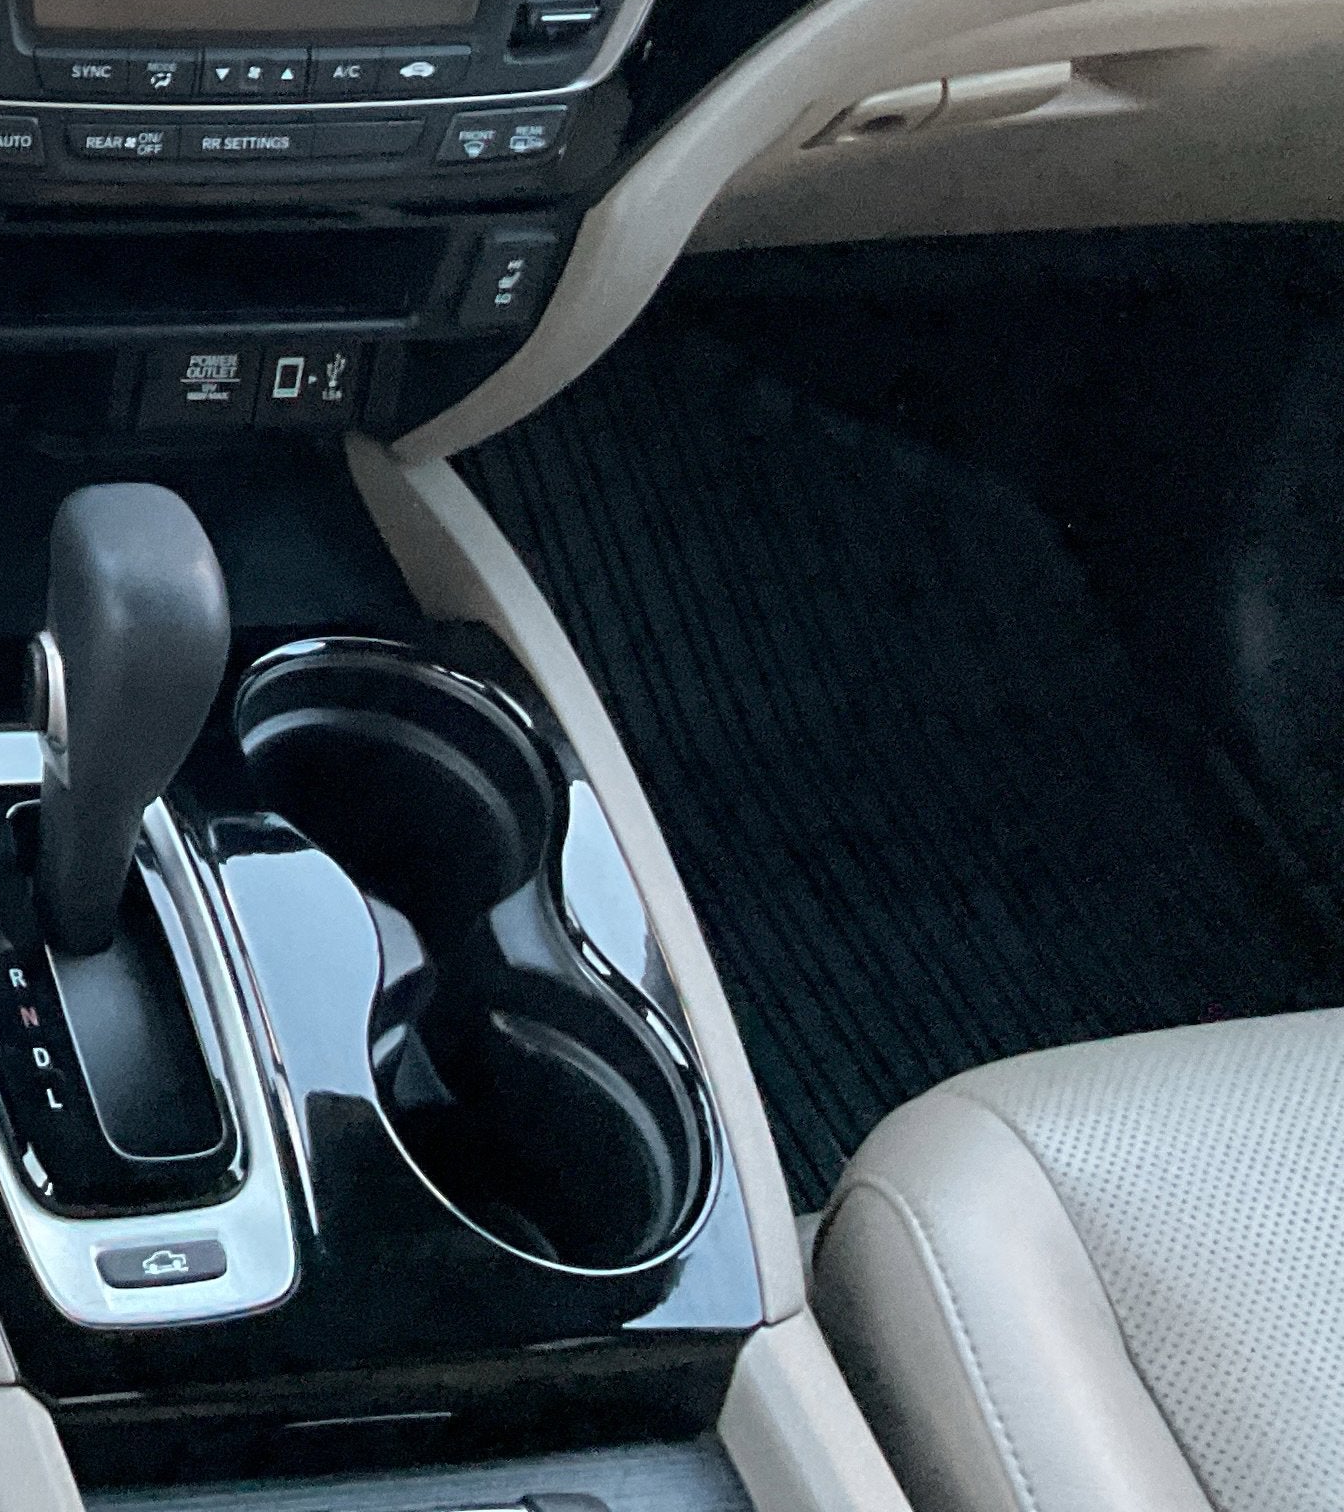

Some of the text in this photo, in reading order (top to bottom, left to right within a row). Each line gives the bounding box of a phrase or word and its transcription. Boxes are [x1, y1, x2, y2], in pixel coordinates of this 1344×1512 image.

[71, 65, 112, 80] SYNC
[332, 64, 362, 79] A/C
[85, 136, 123, 150] REAR
[201, 136, 291, 150] RR SETTINGS
[458, 130, 497, 141] FRONT
[136, 144, 163, 156] OFF
[186, 366, 238, 378] OUTLET
[9, 968, 27, 987] R
[20, 1005, 40, 1027] N
[32, 1047, 50, 1067] D
[46, 1088, 63, 1109] L
